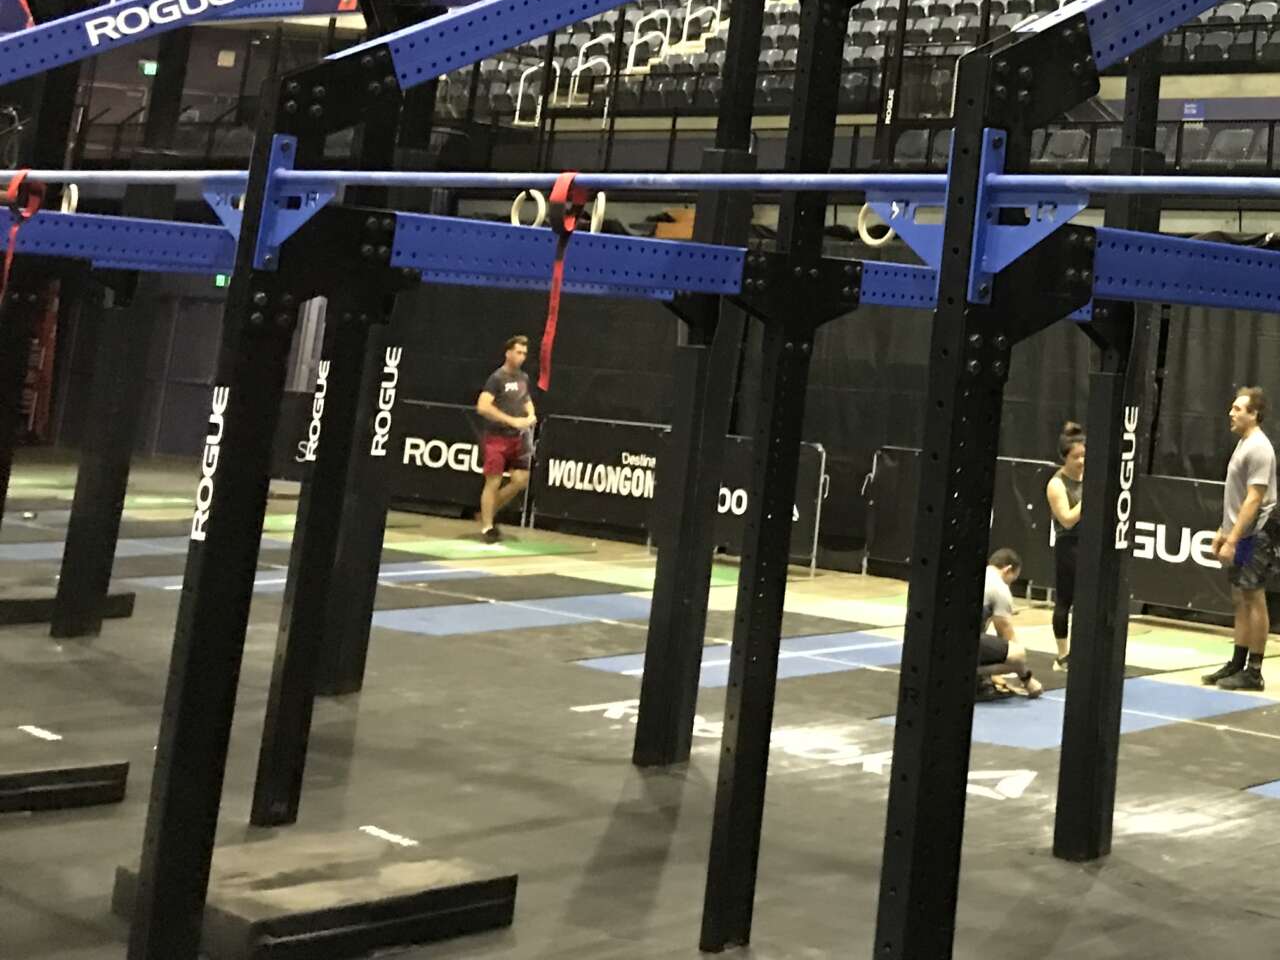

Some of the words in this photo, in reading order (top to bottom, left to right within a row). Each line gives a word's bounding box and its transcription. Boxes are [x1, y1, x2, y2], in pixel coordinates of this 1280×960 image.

[305, 360, 331, 461] ROGUE
[370, 346, 403, 457] ROGUE
[190, 386, 230, 541] ROGUE
[403, 437, 511, 477] ROGU
[548, 457, 656, 499] WOLLONGON
[1114, 406, 1139, 550] ROGUE
